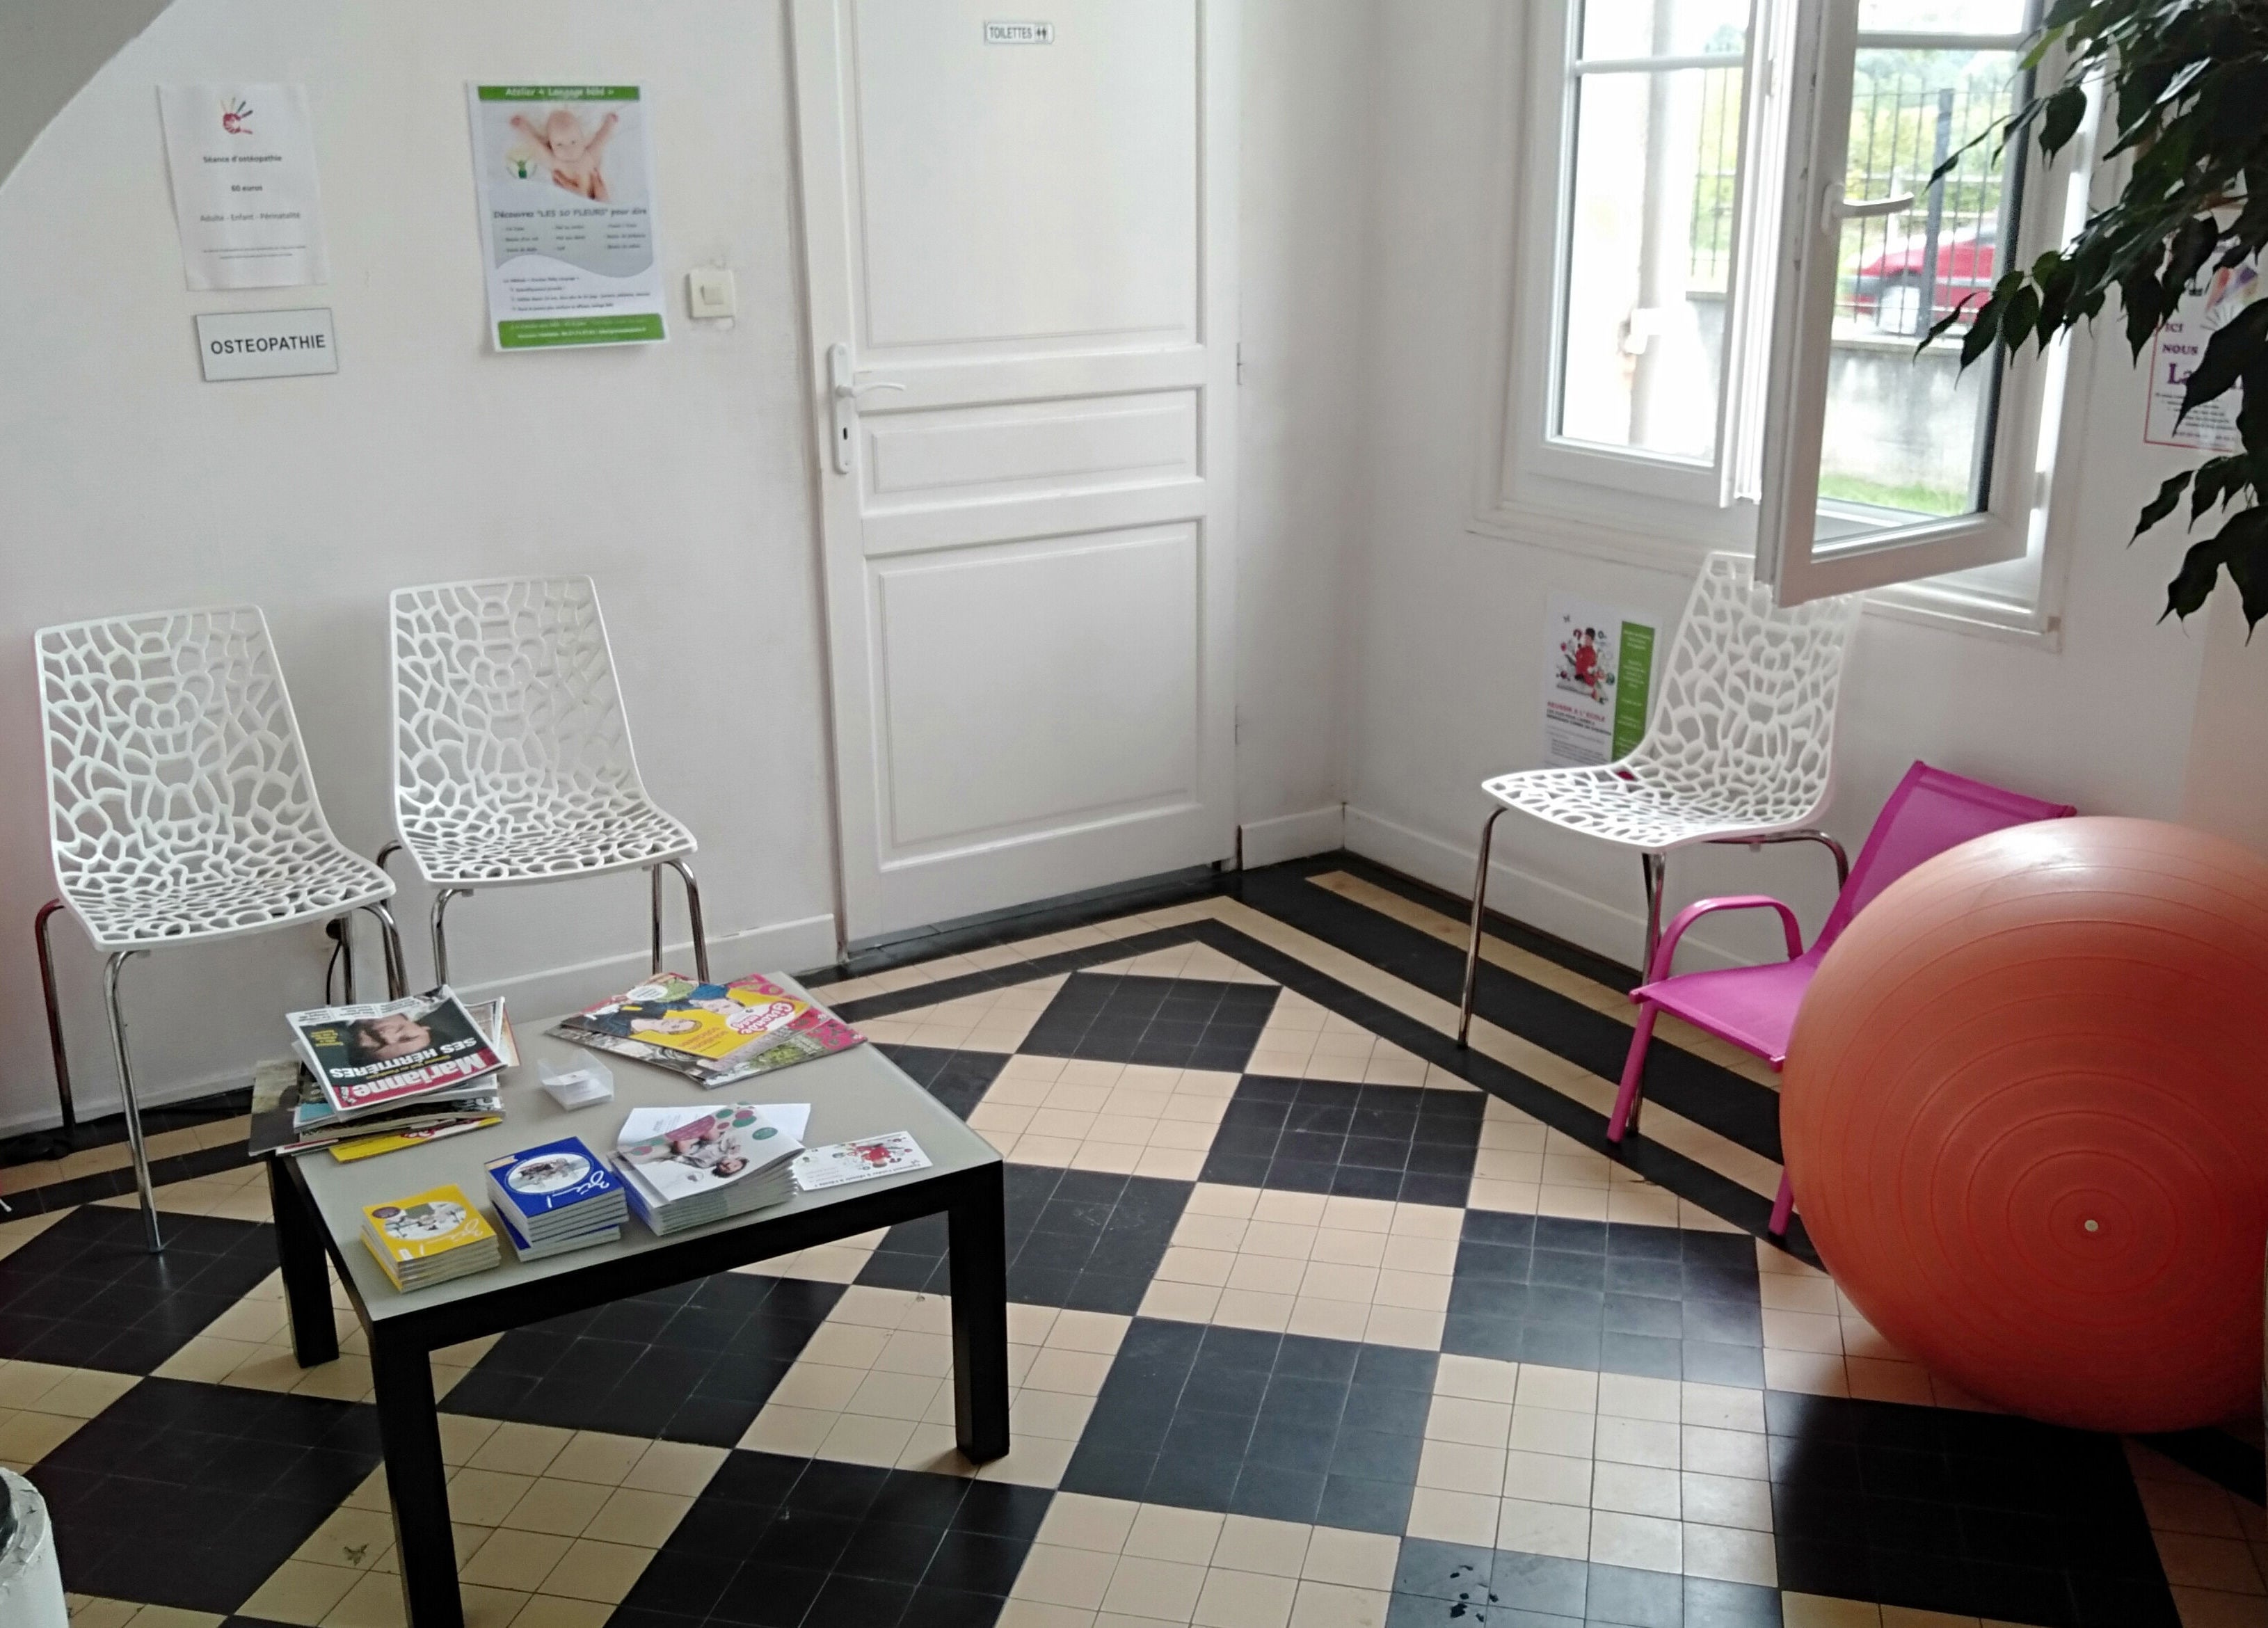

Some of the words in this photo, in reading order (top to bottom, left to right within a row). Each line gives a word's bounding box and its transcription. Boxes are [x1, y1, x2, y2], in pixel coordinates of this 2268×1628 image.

[989, 26, 1032, 39] TOILETTES
[2165, 323, 2183, 333] ICI
[210, 335, 326, 355] OSTEOPATHIE
[2162, 344, 2198, 355] NOUS
[739, 1001, 794, 1035] Gironde
[440, 1037, 477, 1054] SES
[329, 1048, 439, 1079] HÉRITIÈRES
[352, 1052, 487, 1097] Marianne
